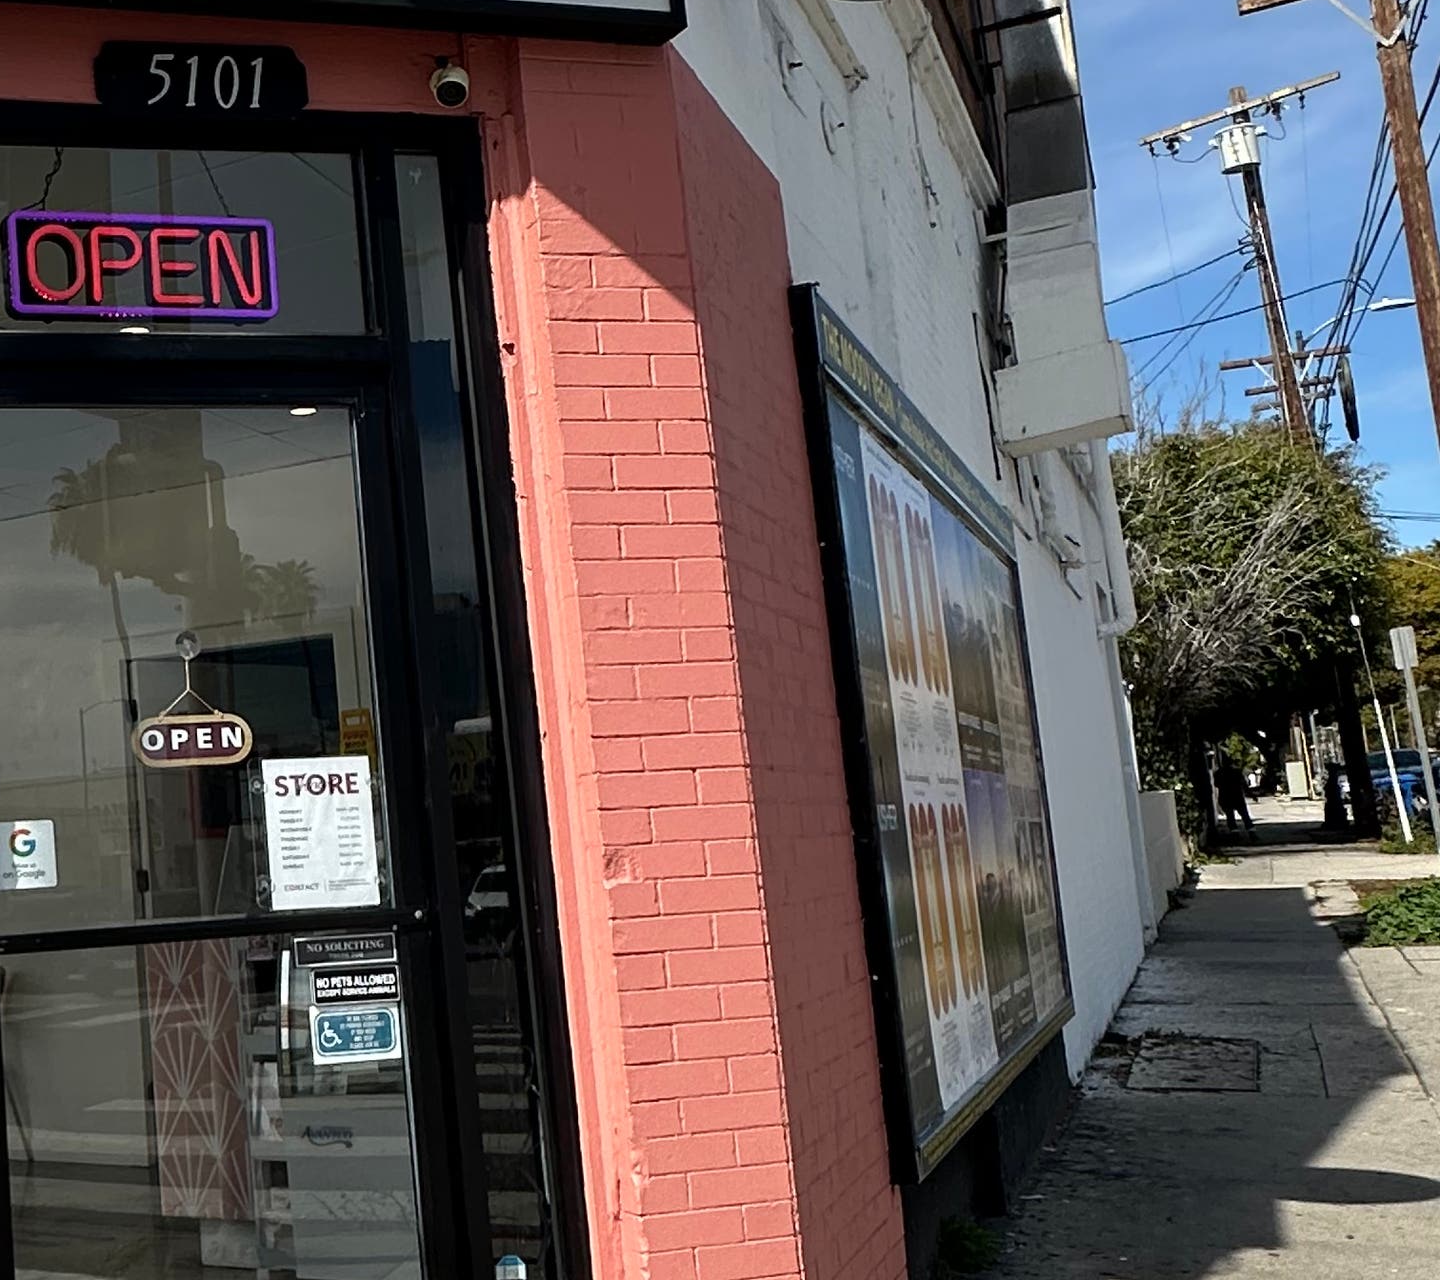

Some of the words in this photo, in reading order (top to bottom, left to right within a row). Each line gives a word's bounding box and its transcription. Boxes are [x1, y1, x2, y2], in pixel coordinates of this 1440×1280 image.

[148, 53, 263, 110] 5101
[25, 224, 262, 306] OPEN
[141, 726, 243, 751] OPEN
[274, 772, 360, 797] STORE
[306, 943, 322, 953] NO
[324, 940, 384, 951] SOLICITING
[316, 978, 329, 989] NO
[331, 976, 353, 988] PETS
[353, 974, 395, 986] ALLOWED
